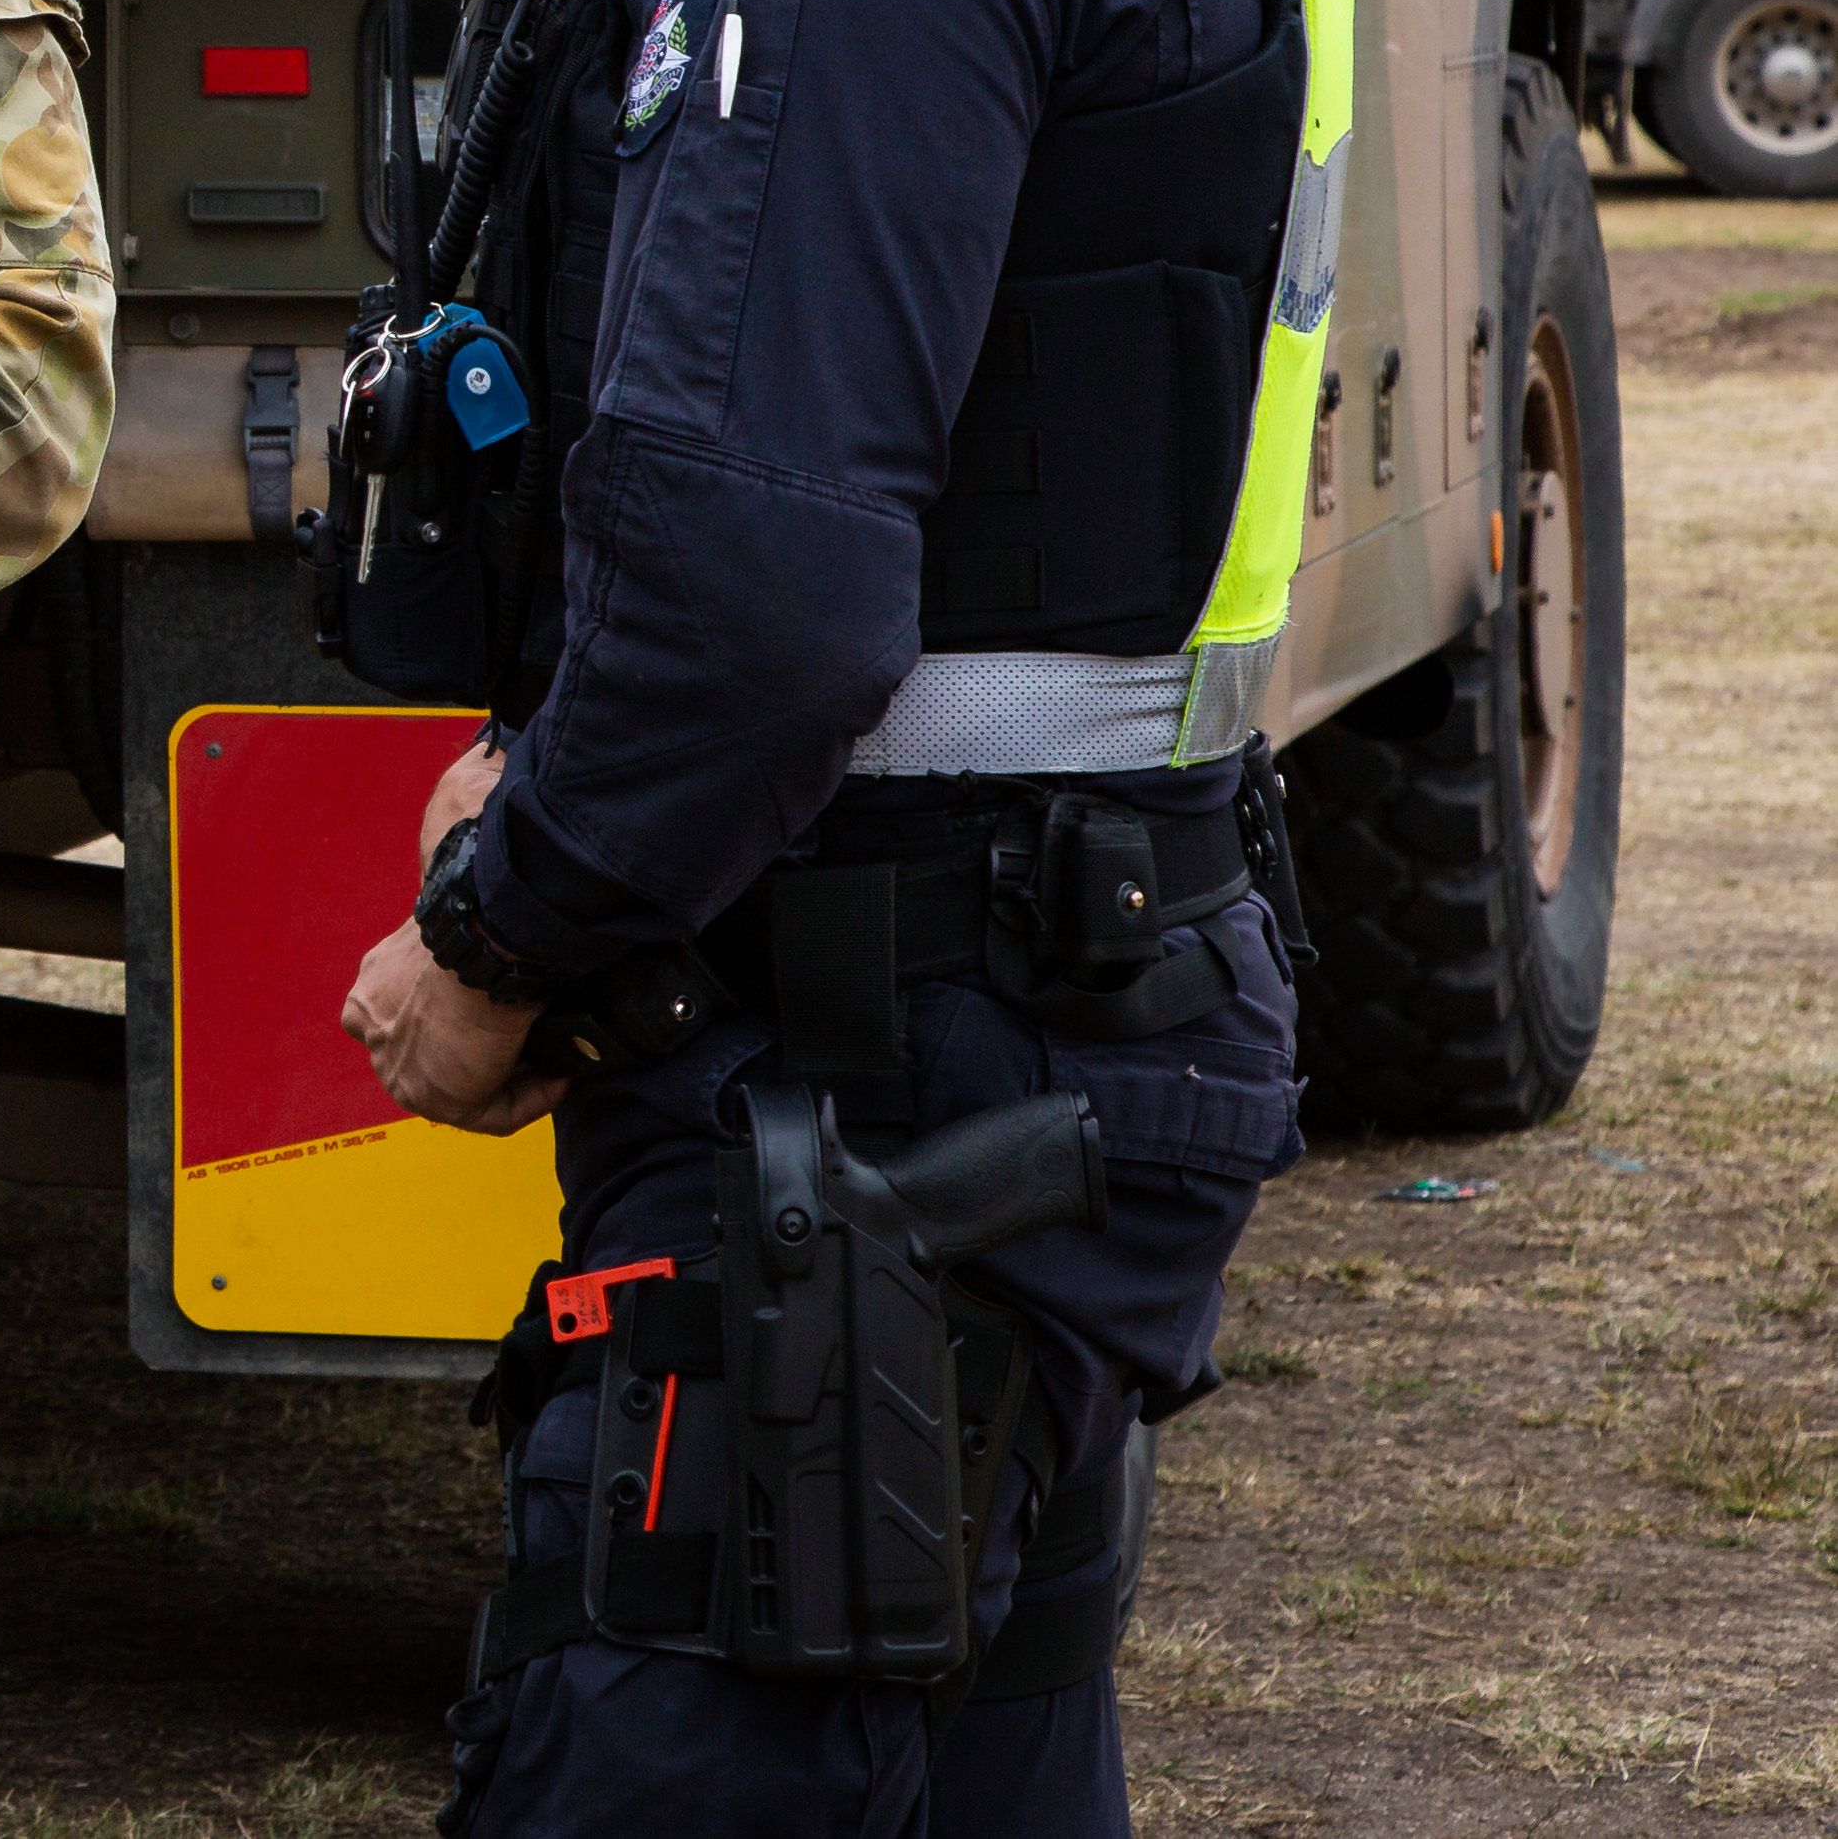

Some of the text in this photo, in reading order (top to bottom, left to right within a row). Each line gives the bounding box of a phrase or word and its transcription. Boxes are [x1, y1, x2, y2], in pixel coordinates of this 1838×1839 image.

[253, 1147, 304, 1167] CLASS
[307, 1145, 318, 1156] 2
[323, 1140, 339, 1152] M
